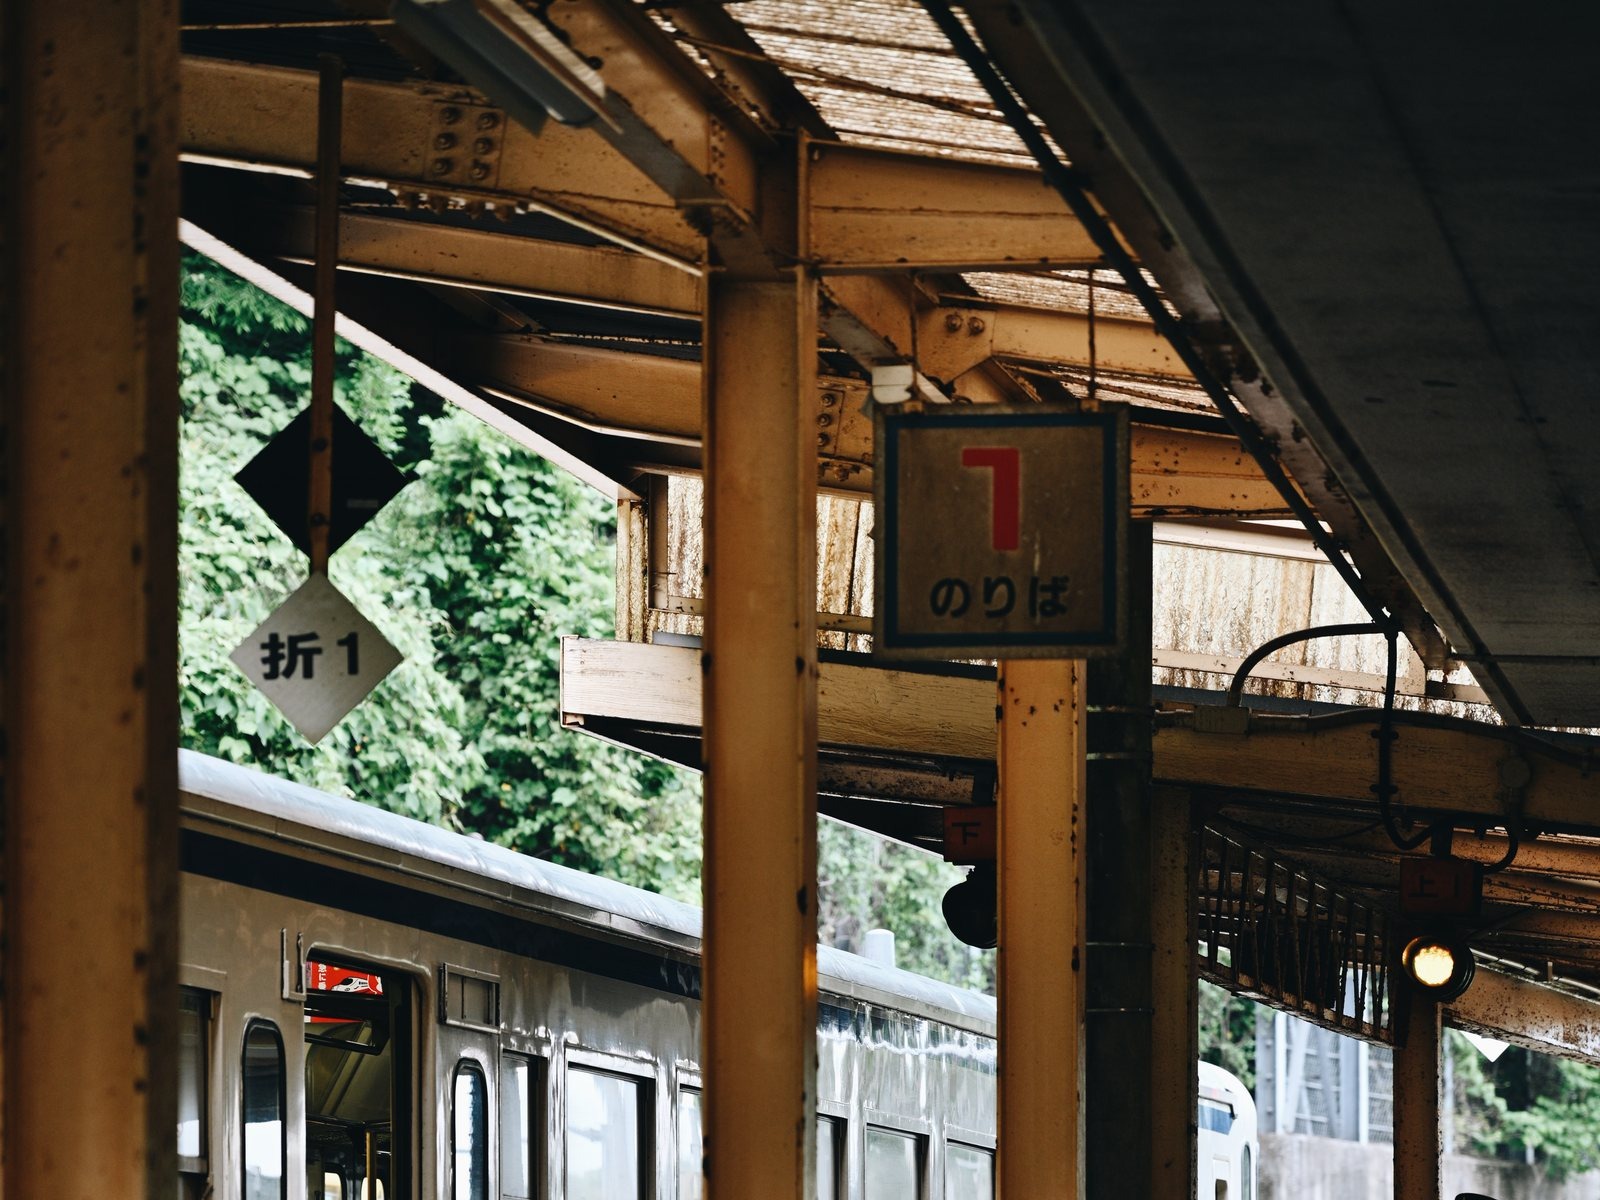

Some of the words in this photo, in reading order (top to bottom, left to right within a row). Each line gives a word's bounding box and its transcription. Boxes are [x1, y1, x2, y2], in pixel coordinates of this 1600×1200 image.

[962, 447, 1020, 551] 1
[930, 575, 1070, 619] のりば
